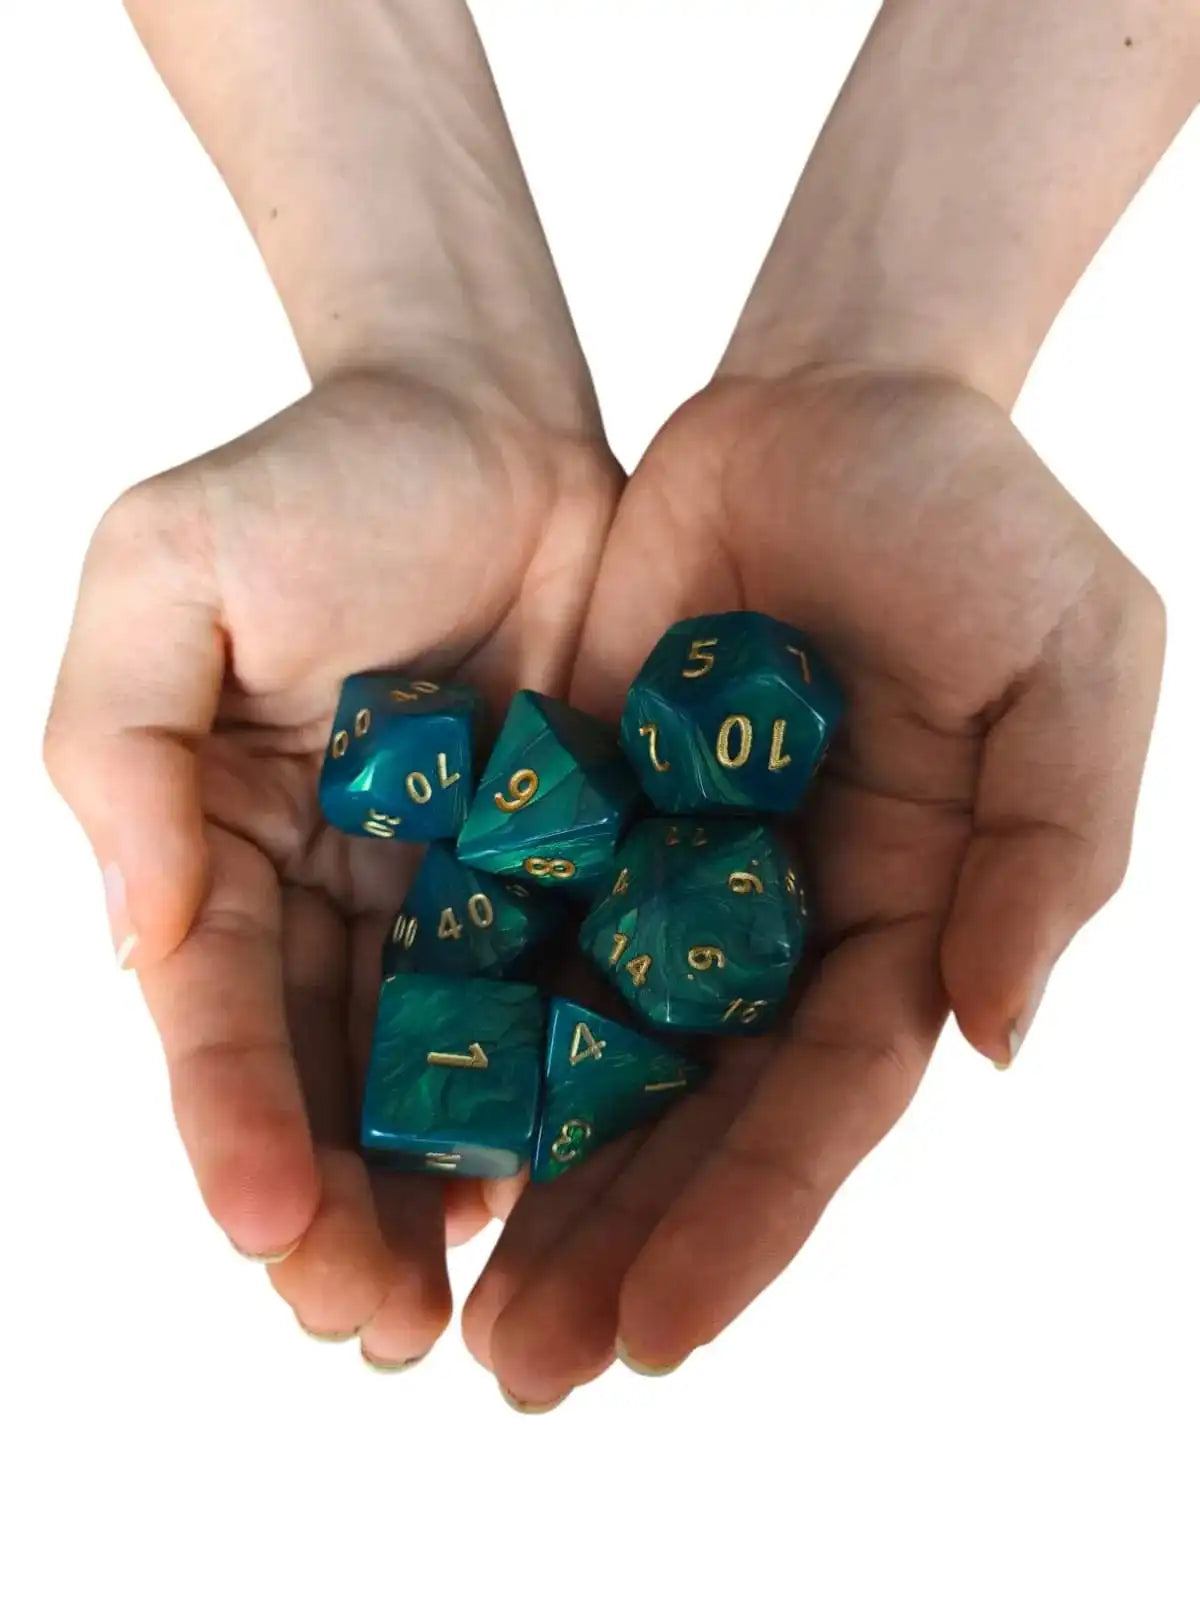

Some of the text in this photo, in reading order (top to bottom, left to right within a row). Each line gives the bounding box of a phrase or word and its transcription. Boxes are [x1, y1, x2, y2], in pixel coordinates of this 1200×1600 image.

[682, 638, 718, 678] 5
[716, 714, 792, 773] 10
[406, 752, 460, 804] 70
[525, 857, 576, 879] 8
[438, 892, 493, 940] 40
[609, 933, 651, 987] 14
[427, 1042, 488, 1068] 1
[569, 1022, 607, 1066] 4
